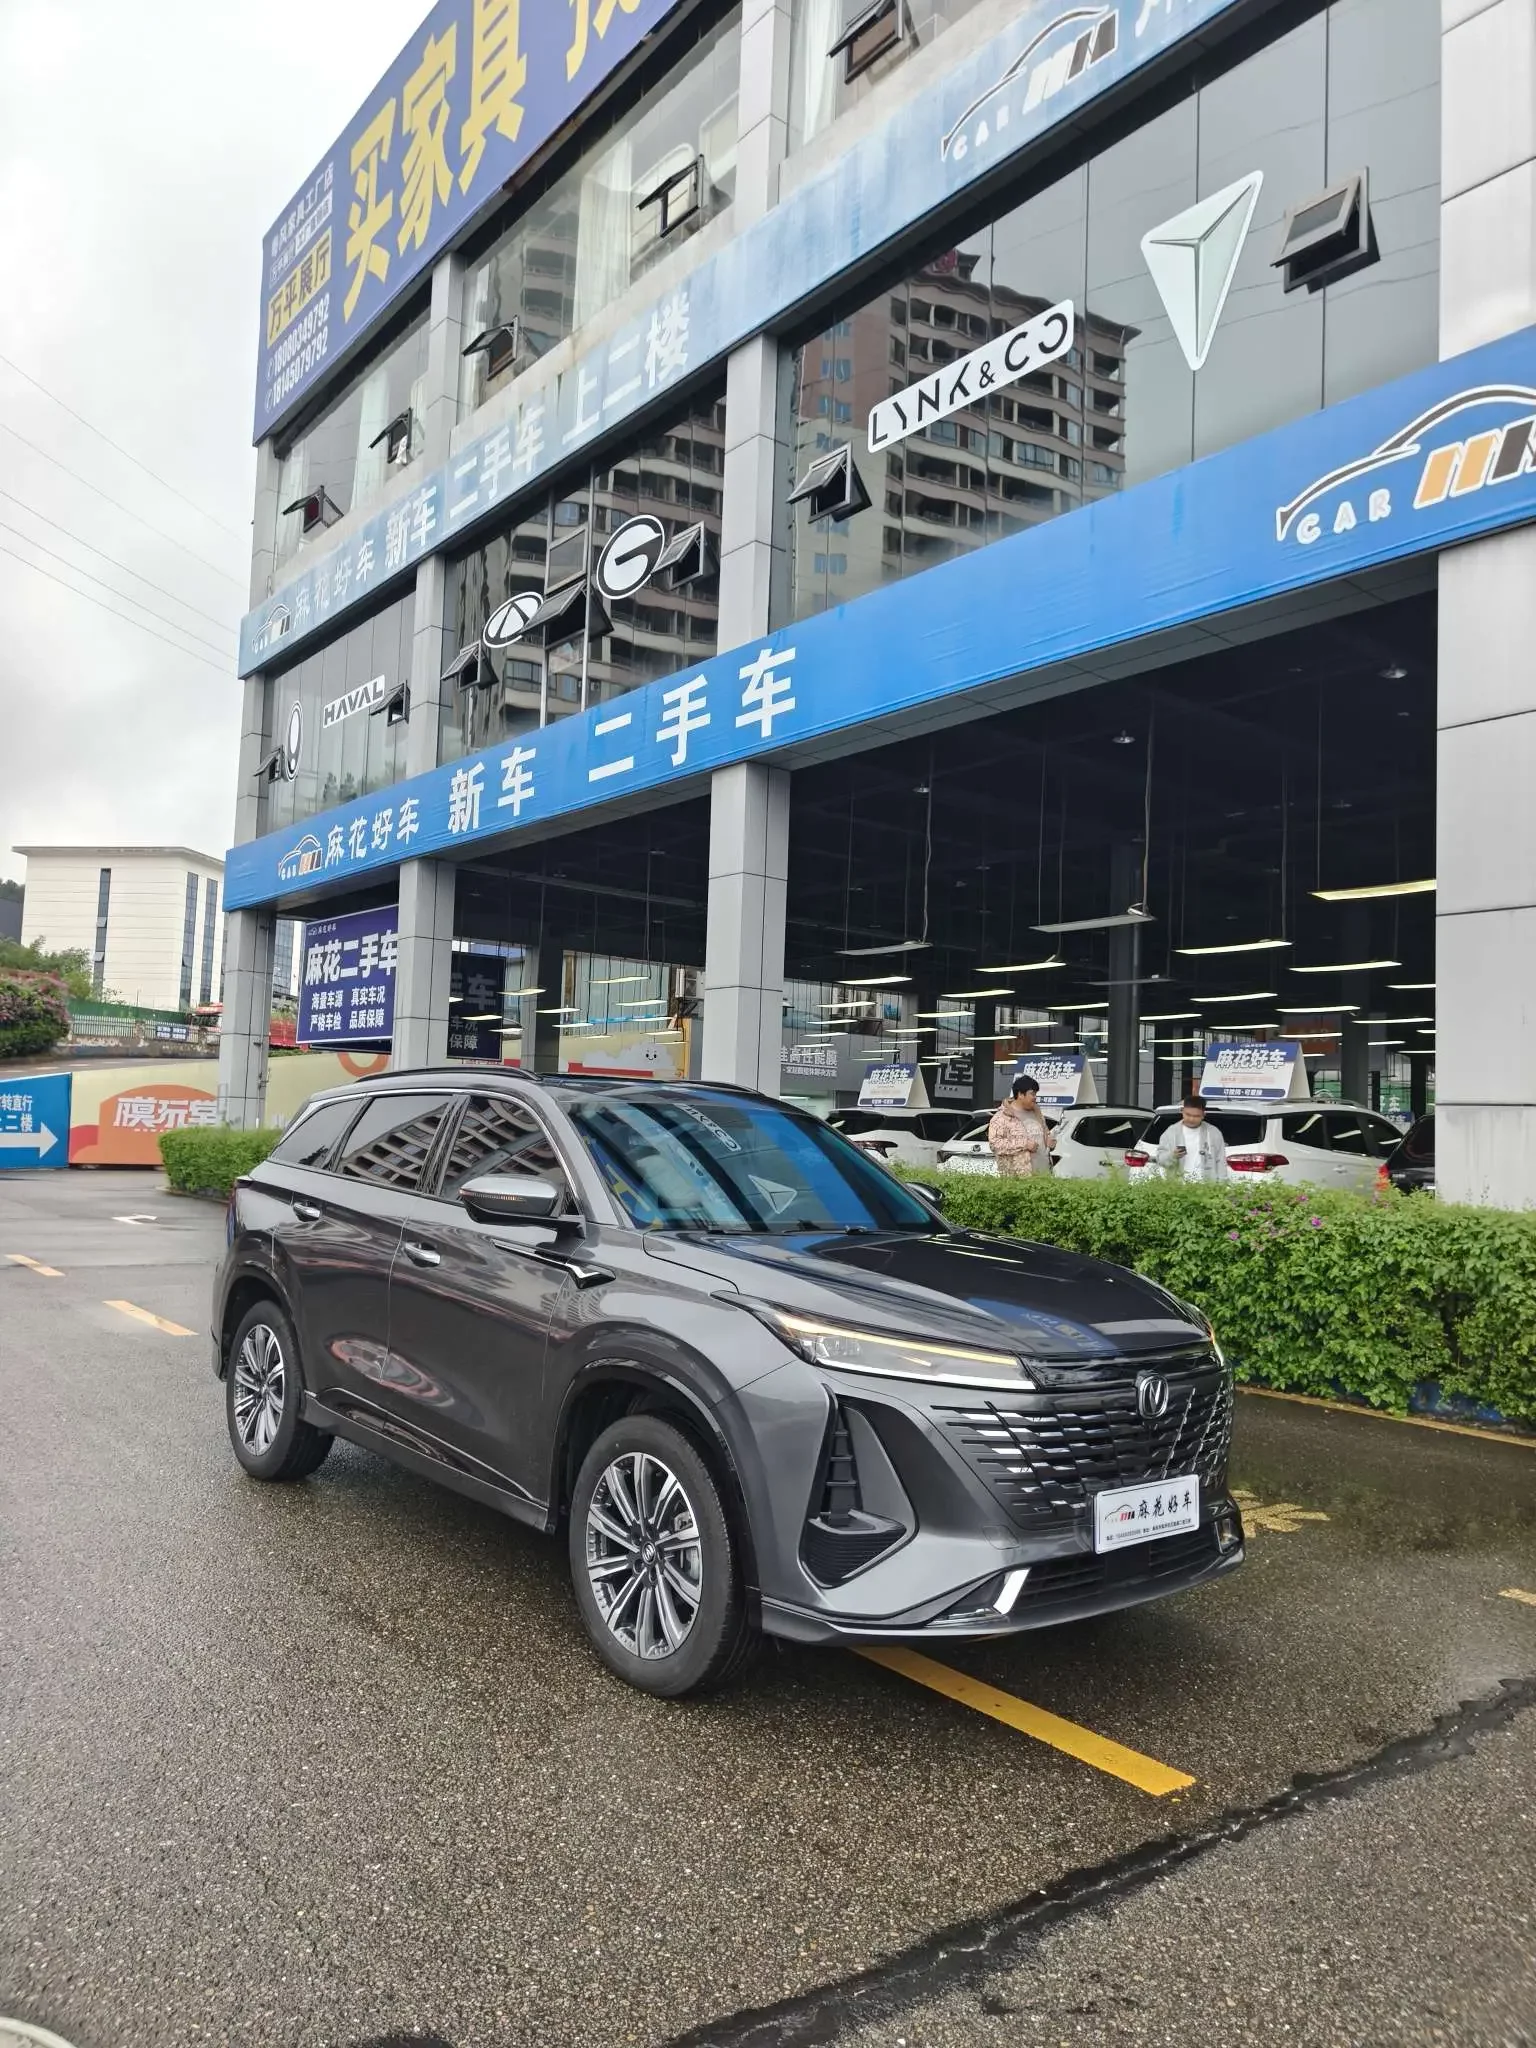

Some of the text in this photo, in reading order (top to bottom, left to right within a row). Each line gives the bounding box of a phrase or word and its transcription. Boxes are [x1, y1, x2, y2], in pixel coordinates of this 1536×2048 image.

[872, 312, 1068, 446] LYNK&CO
[385, 485, 437, 571] 新车
[449, 405, 545, 519] 二手车
[562, 291, 690, 445] 上二楼
[1297, 489, 1391, 544] CAR
[324, 680, 384, 726] HAVAL
[325, 647, 796, 869] 麻花好车 新车 二手车
[304, 929, 399, 987] 麻花二手车
[309, 1008, 385, 1033] 严格车检 品质保障
[311, 985, 386, 1011] 海量车源 真实车况
[1024, 1060, 1077, 1081] 麻花好车
[1216, 1048, 1287, 1070] 麻花好车
[1138, 1490, 1192, 1519] 麻花好车
